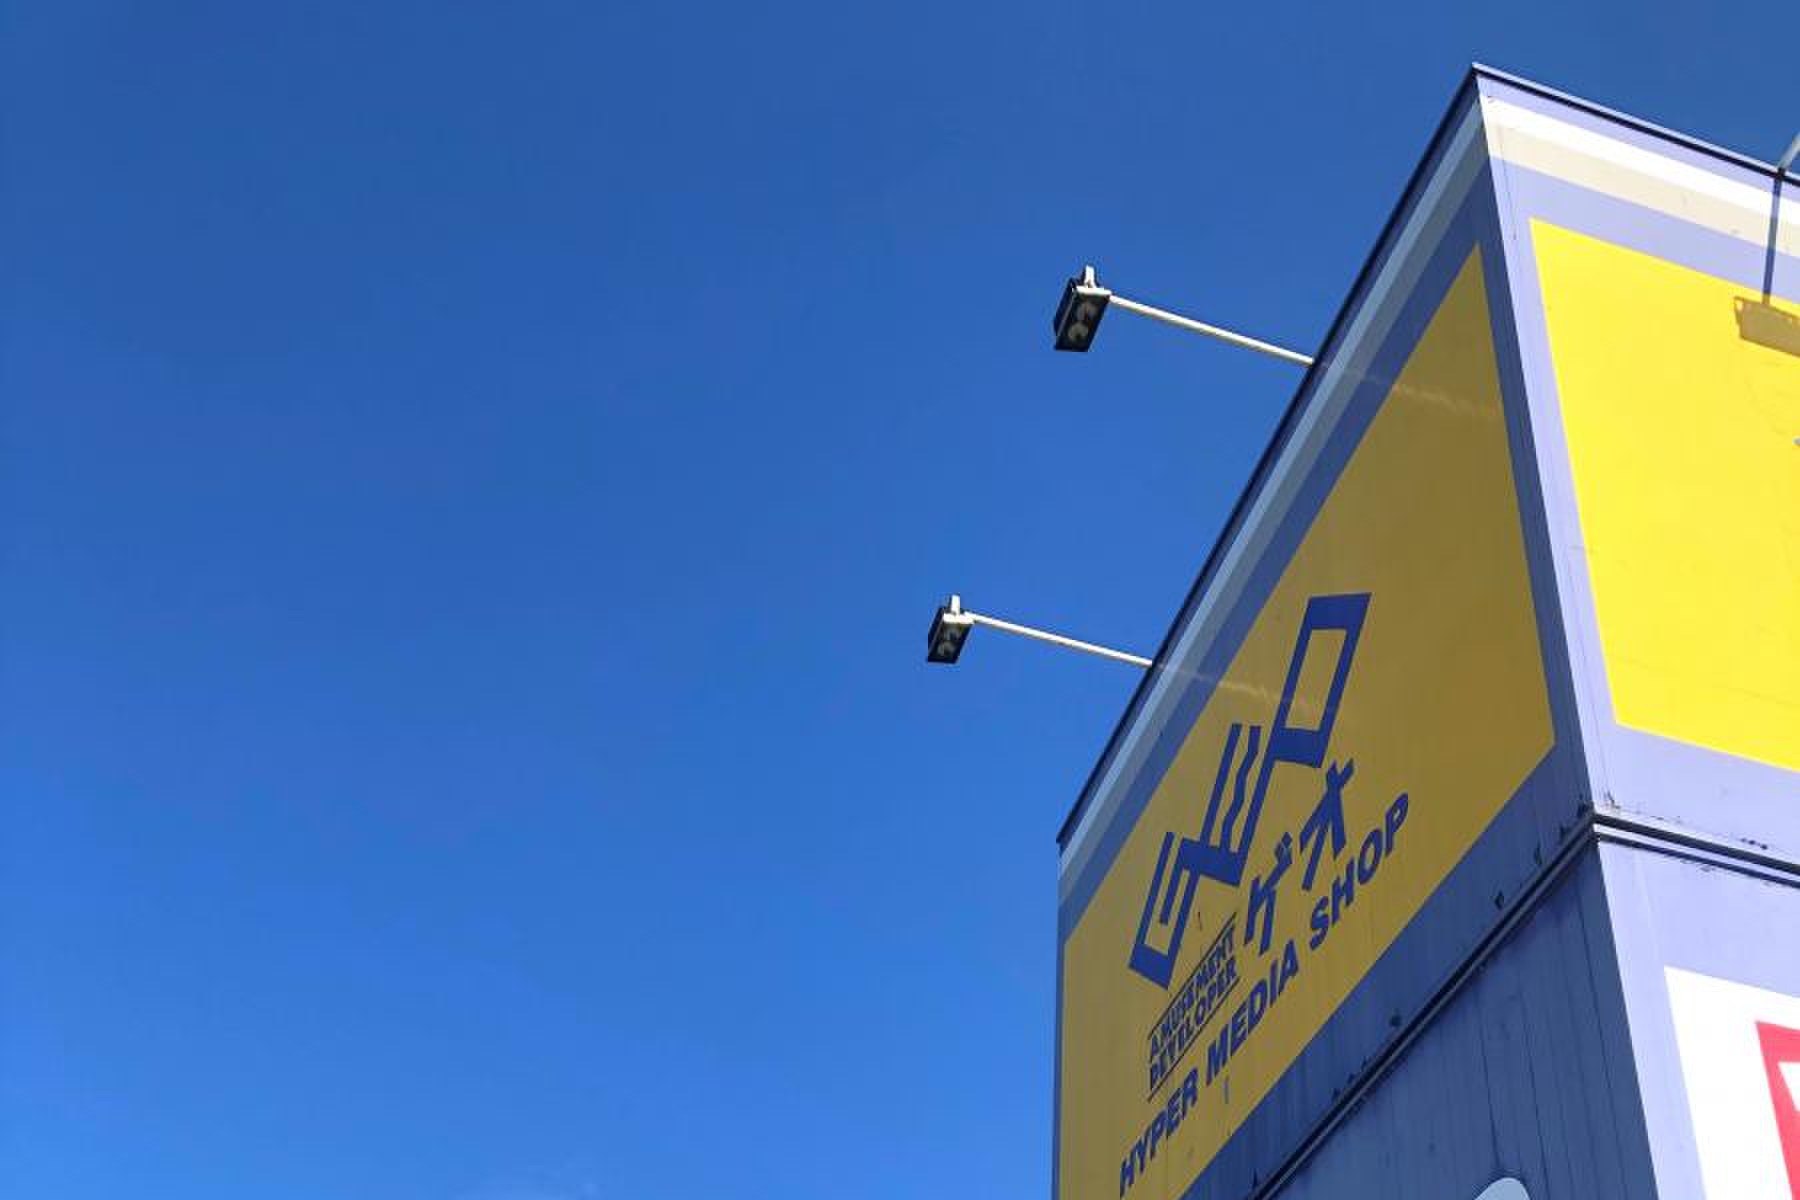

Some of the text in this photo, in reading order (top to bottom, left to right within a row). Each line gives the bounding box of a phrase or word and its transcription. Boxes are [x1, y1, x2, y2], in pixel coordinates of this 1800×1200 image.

[1243, 757, 1354, 956] ゲオ
[1119, 792, 1409, 1200] HYPER MEDIA SHOP
[1150, 924, 1235, 1063] AMUSEMENT
[1150, 956, 1238, 1092] DEVELOPER
